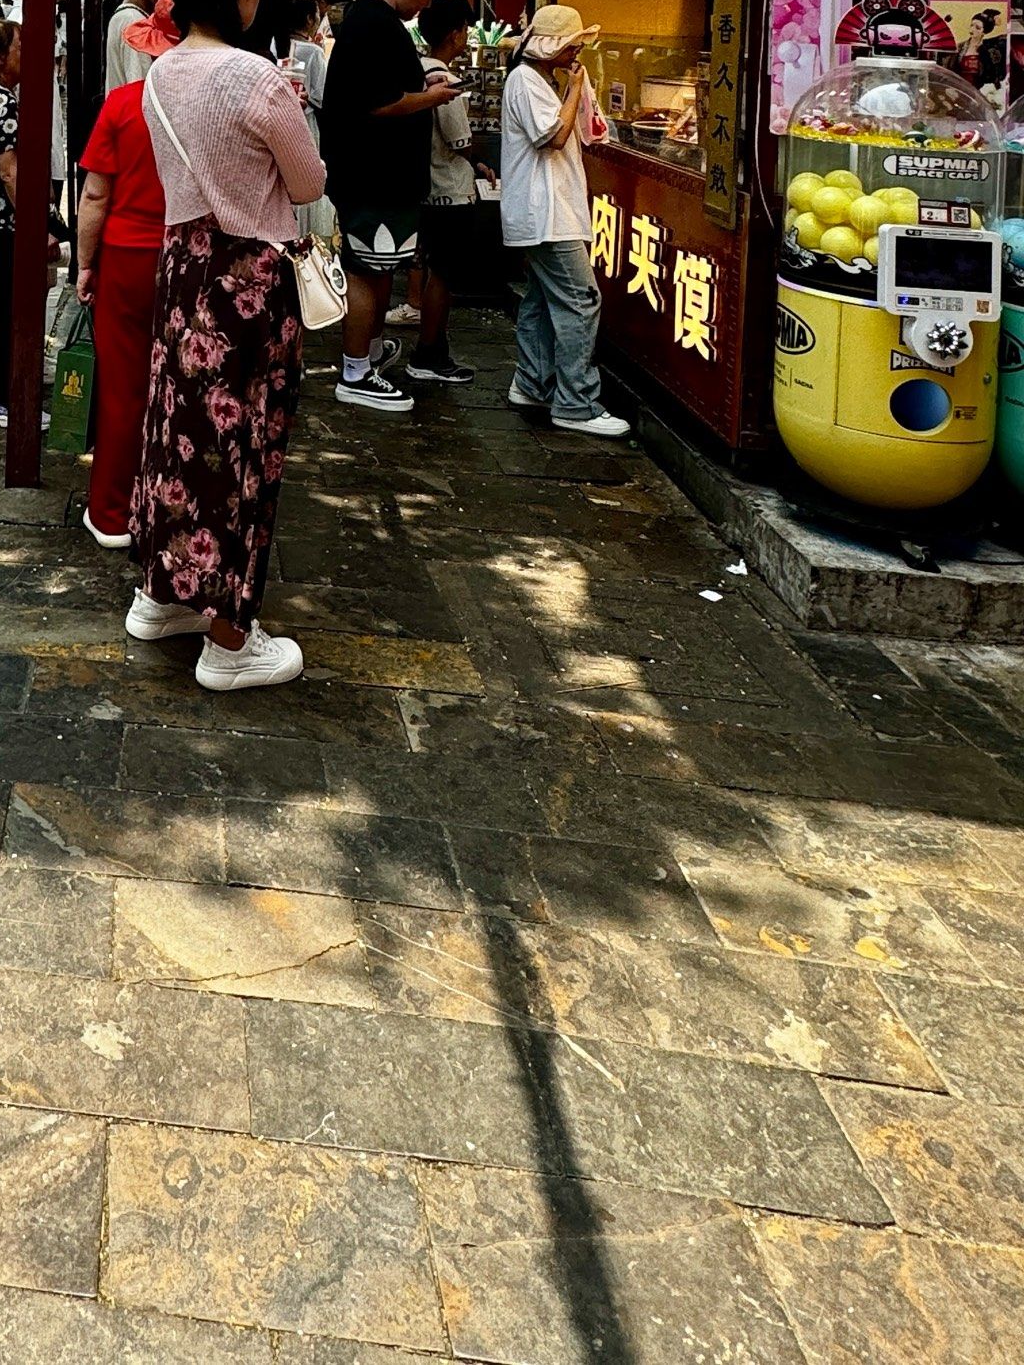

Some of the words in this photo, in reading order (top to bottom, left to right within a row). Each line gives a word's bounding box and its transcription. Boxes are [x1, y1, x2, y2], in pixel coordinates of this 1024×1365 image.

[898, 155, 979, 170] SUPMIA
[898, 169, 944, 179] SPACE
[948, 172, 979, 181] CAPS
[589, 193, 719, 363] 肉夹馍
